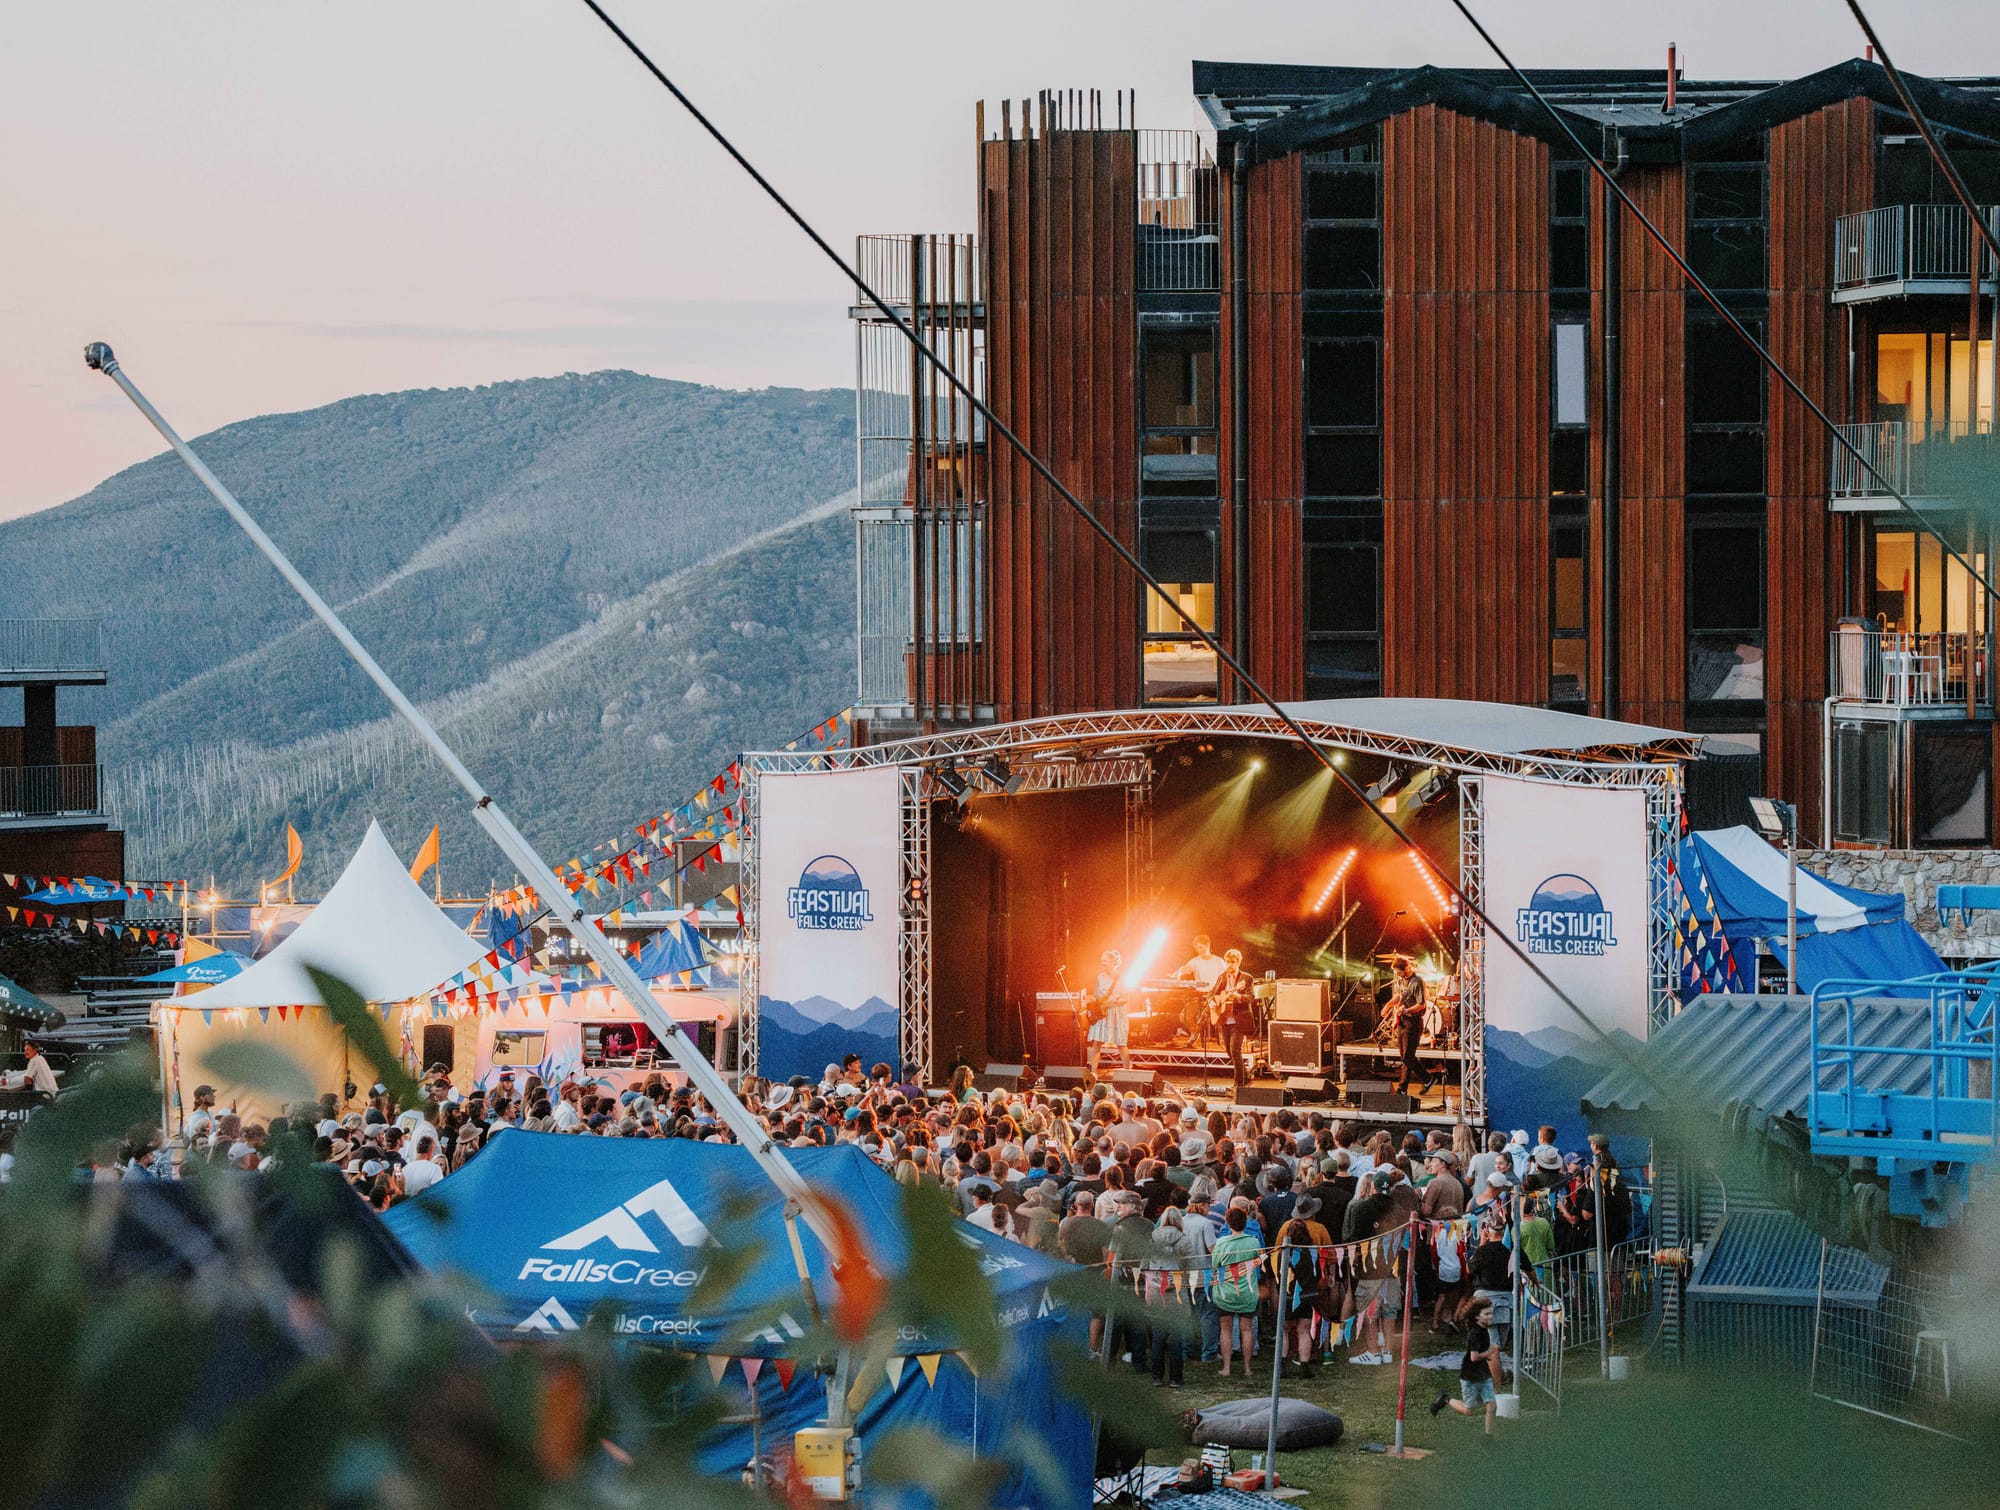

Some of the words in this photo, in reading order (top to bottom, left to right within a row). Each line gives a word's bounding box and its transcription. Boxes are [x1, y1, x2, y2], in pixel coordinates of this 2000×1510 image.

[798, 914, 826, 929] FALLS
[829, 915, 862, 929] CREEK
[1529, 938, 1561, 954] FALLS
[1565, 939, 1604, 955] CREEK
[186, 966, 222, 975] Over
[613, 1313, 702, 1336] llsCreek
